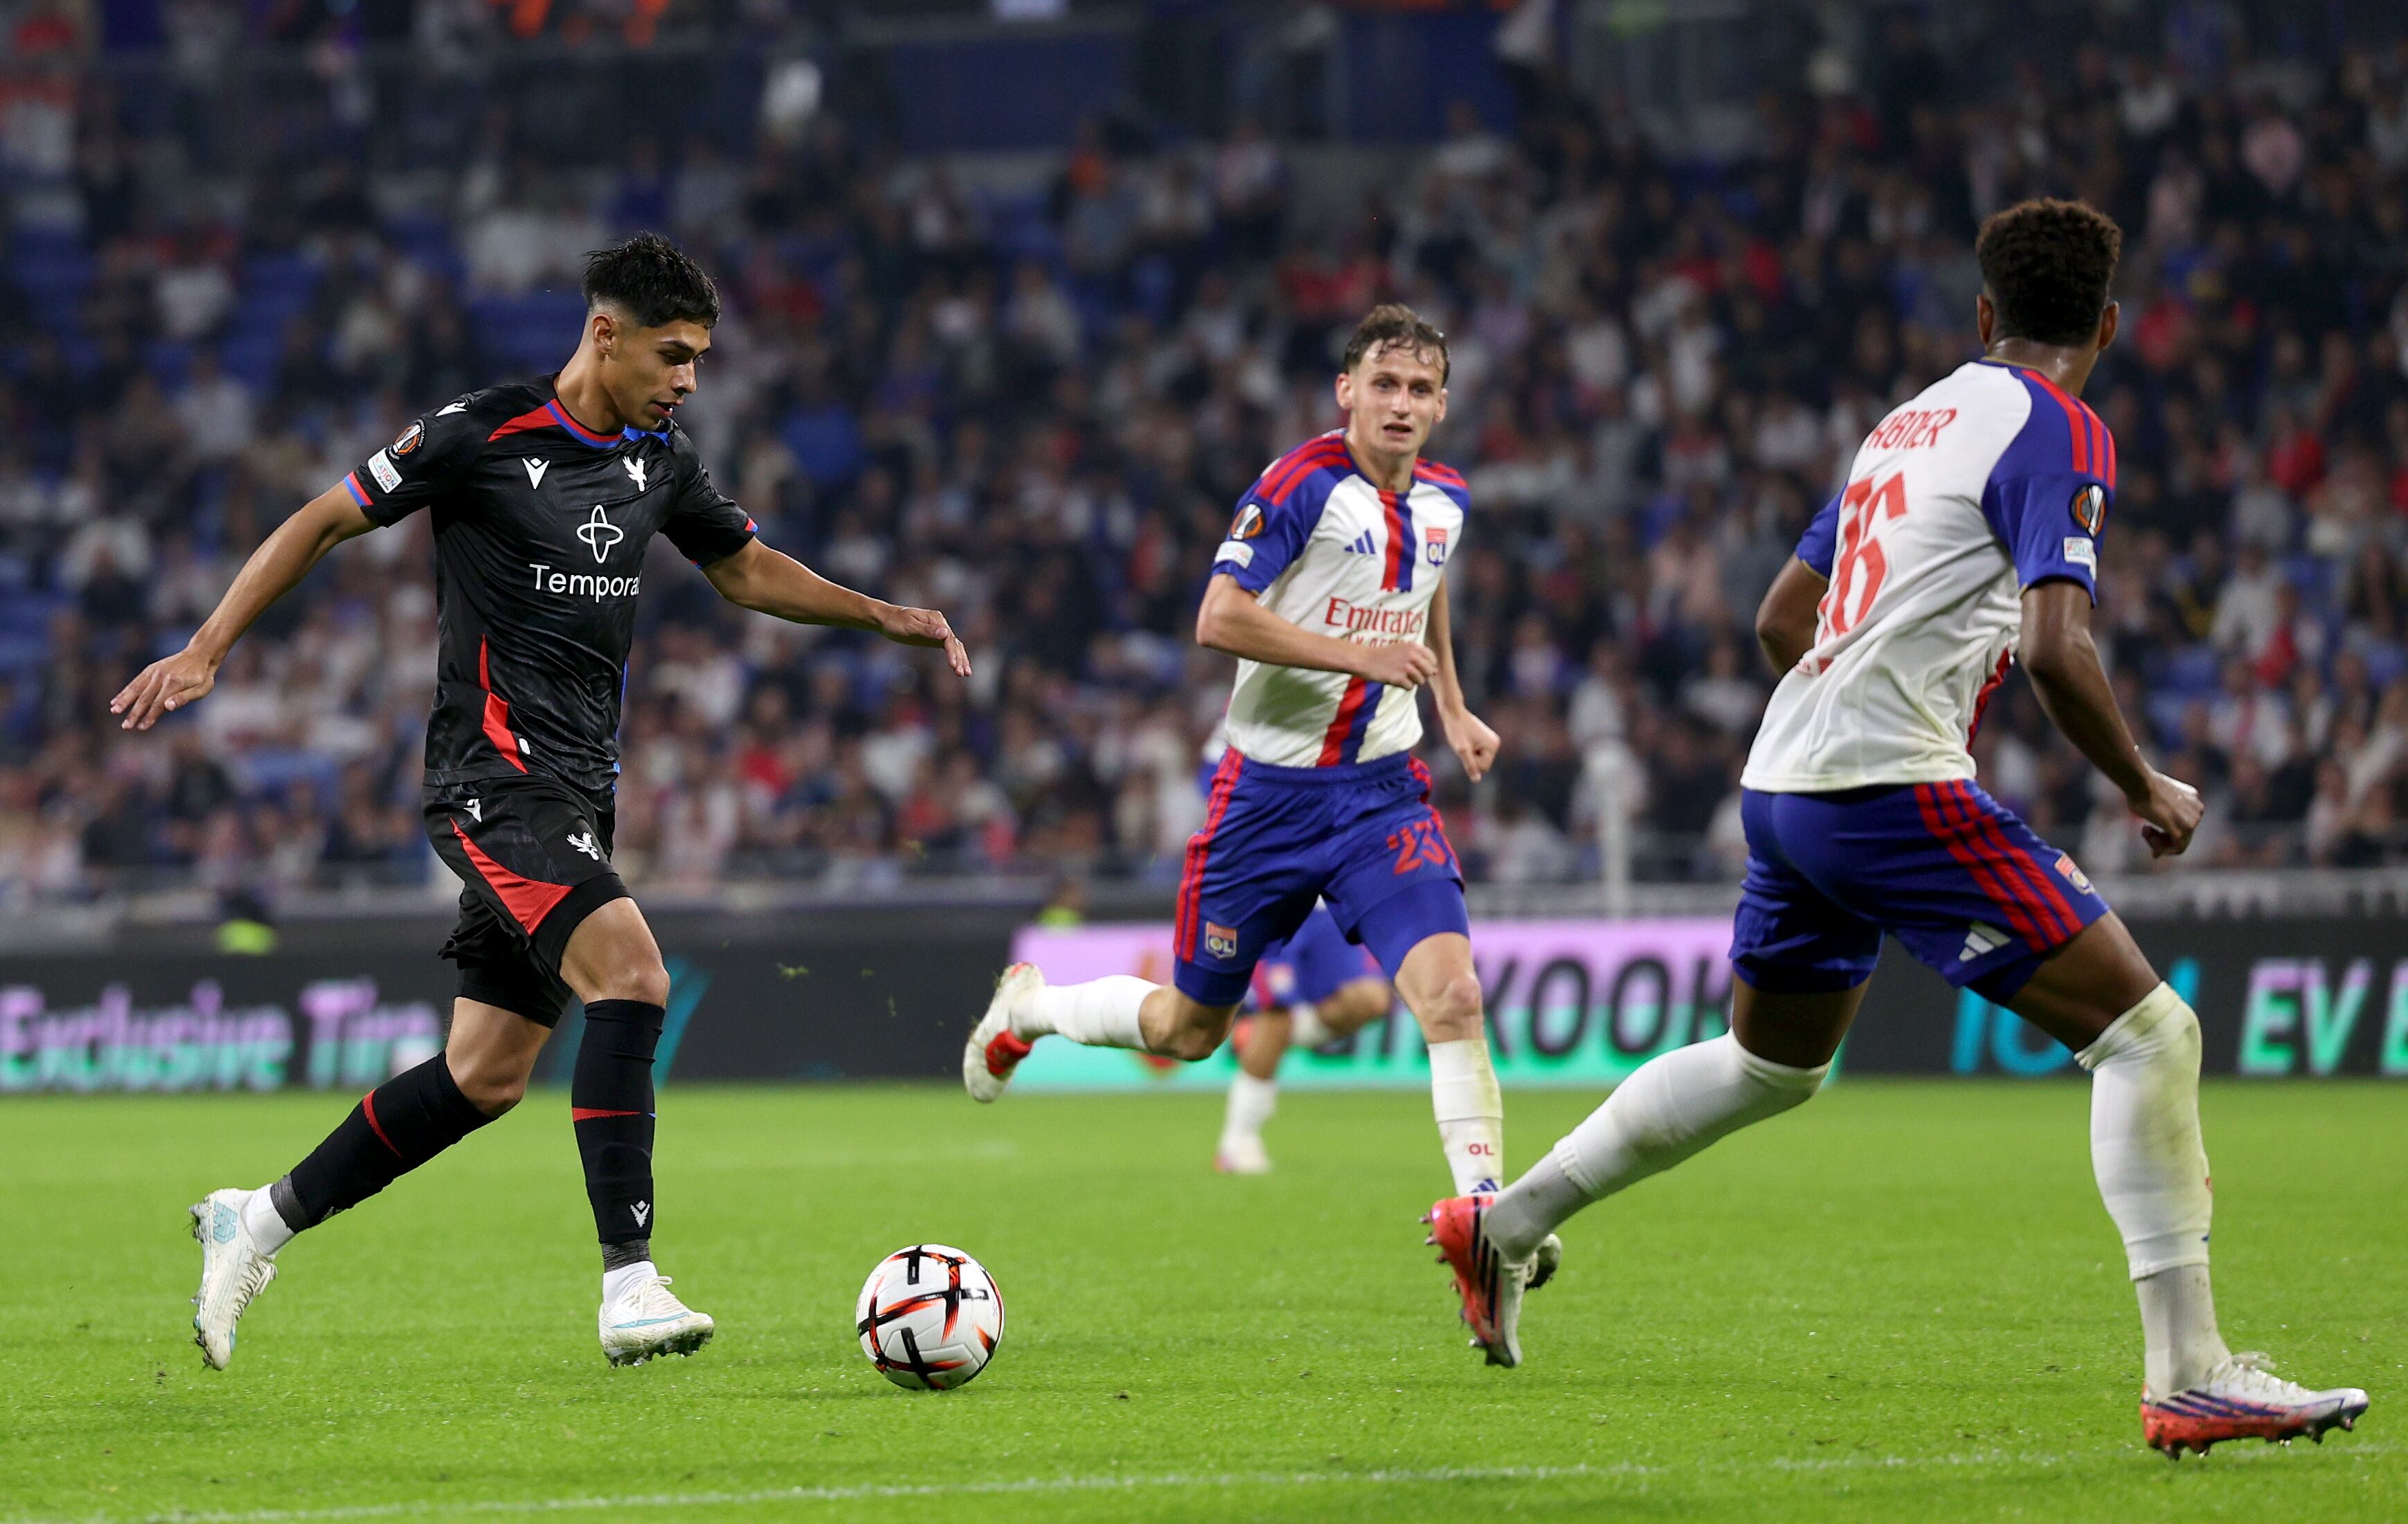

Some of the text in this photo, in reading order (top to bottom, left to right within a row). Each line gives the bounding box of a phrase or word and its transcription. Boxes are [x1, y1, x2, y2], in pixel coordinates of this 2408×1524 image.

[1866, 406, 1957, 450] ABNER
[1816, 470, 1908, 648] 16
[1386, 820, 1446, 876] 23
[1209, 936, 1233, 953] OL
[0, 981, 294, 1092] Exclusive
[2238, 957, 2373, 1076] EV
[1468, 1143, 1495, 1156] OL
